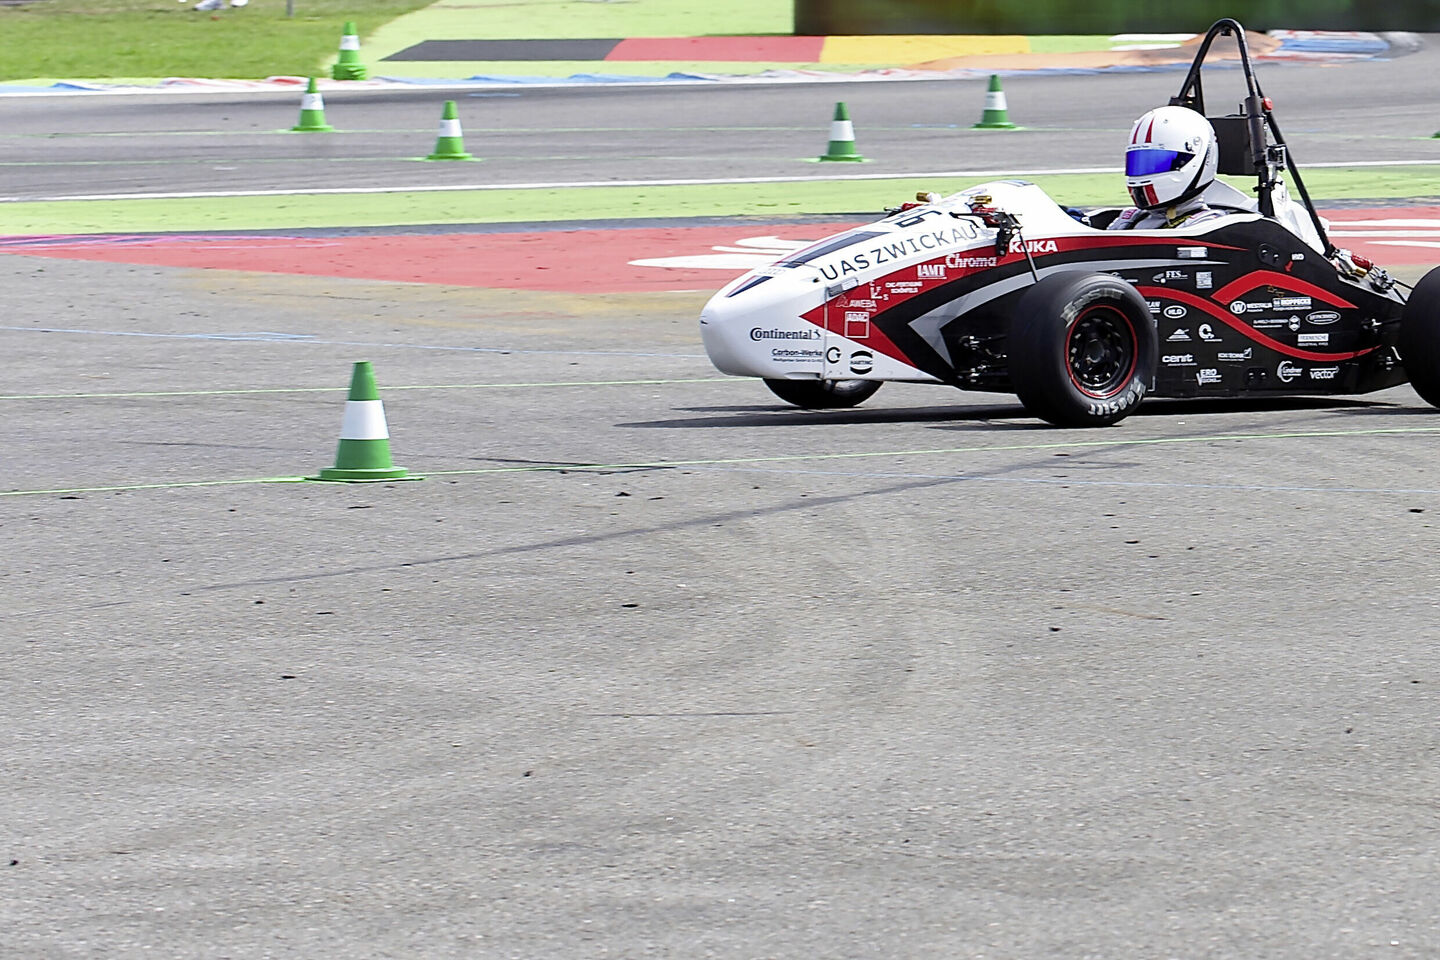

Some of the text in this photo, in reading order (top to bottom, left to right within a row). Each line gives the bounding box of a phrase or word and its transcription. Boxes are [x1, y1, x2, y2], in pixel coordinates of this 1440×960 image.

[946, 253, 997, 269] Chroma
[750, 327, 812, 341] Continental
[1310, 370, 1337, 380] vector
